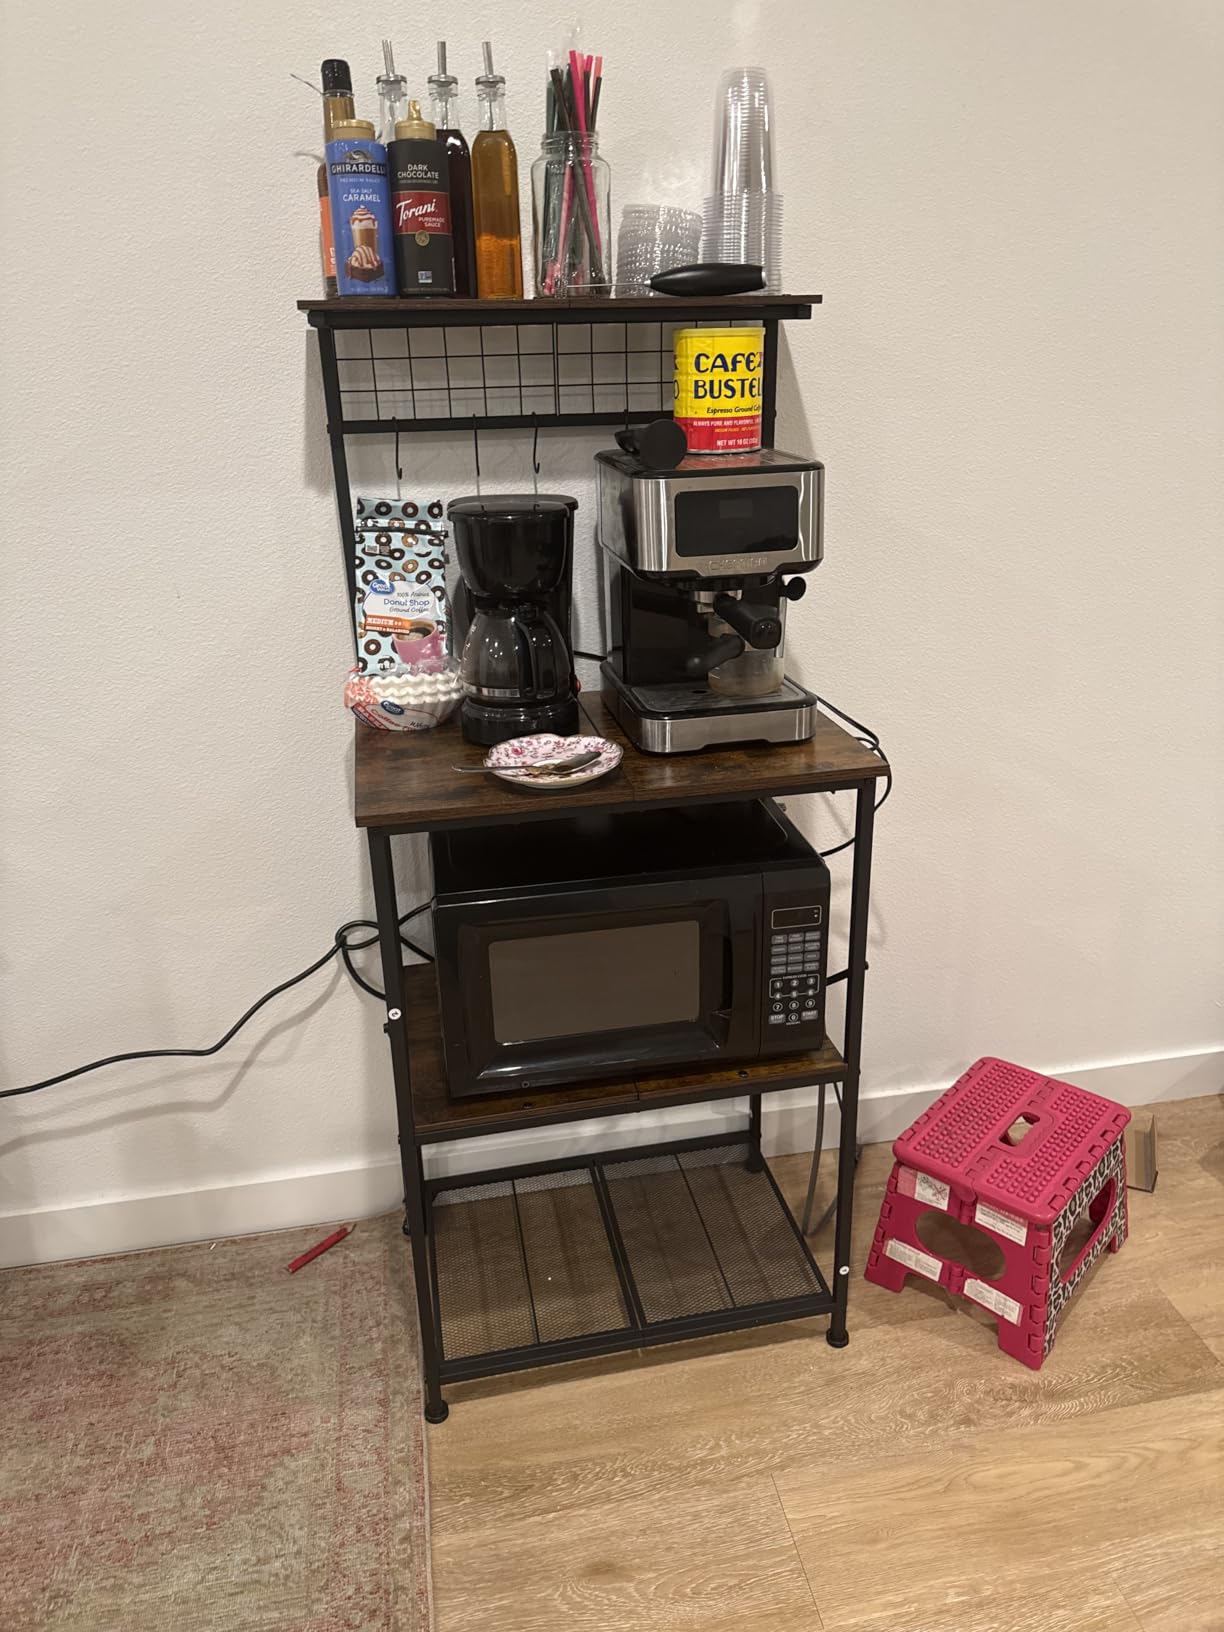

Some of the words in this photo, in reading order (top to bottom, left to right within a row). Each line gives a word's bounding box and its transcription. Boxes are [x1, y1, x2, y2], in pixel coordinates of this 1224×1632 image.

[331, 163, 386, 174] GHIRARDELL
[407, 163, 429, 171] DARK
[397, 171, 440, 179] CHOCOLATE
[342, 193, 381, 202] CARAMEL
[395, 198, 437, 228] Torani
[693, 377, 762, 400] BUSTEL
[706, 406, 733, 415] Espresso
[734, 405, 753, 413] Ground
[383, 598, 407, 607] Donut
[409, 599, 430, 608] Shop
